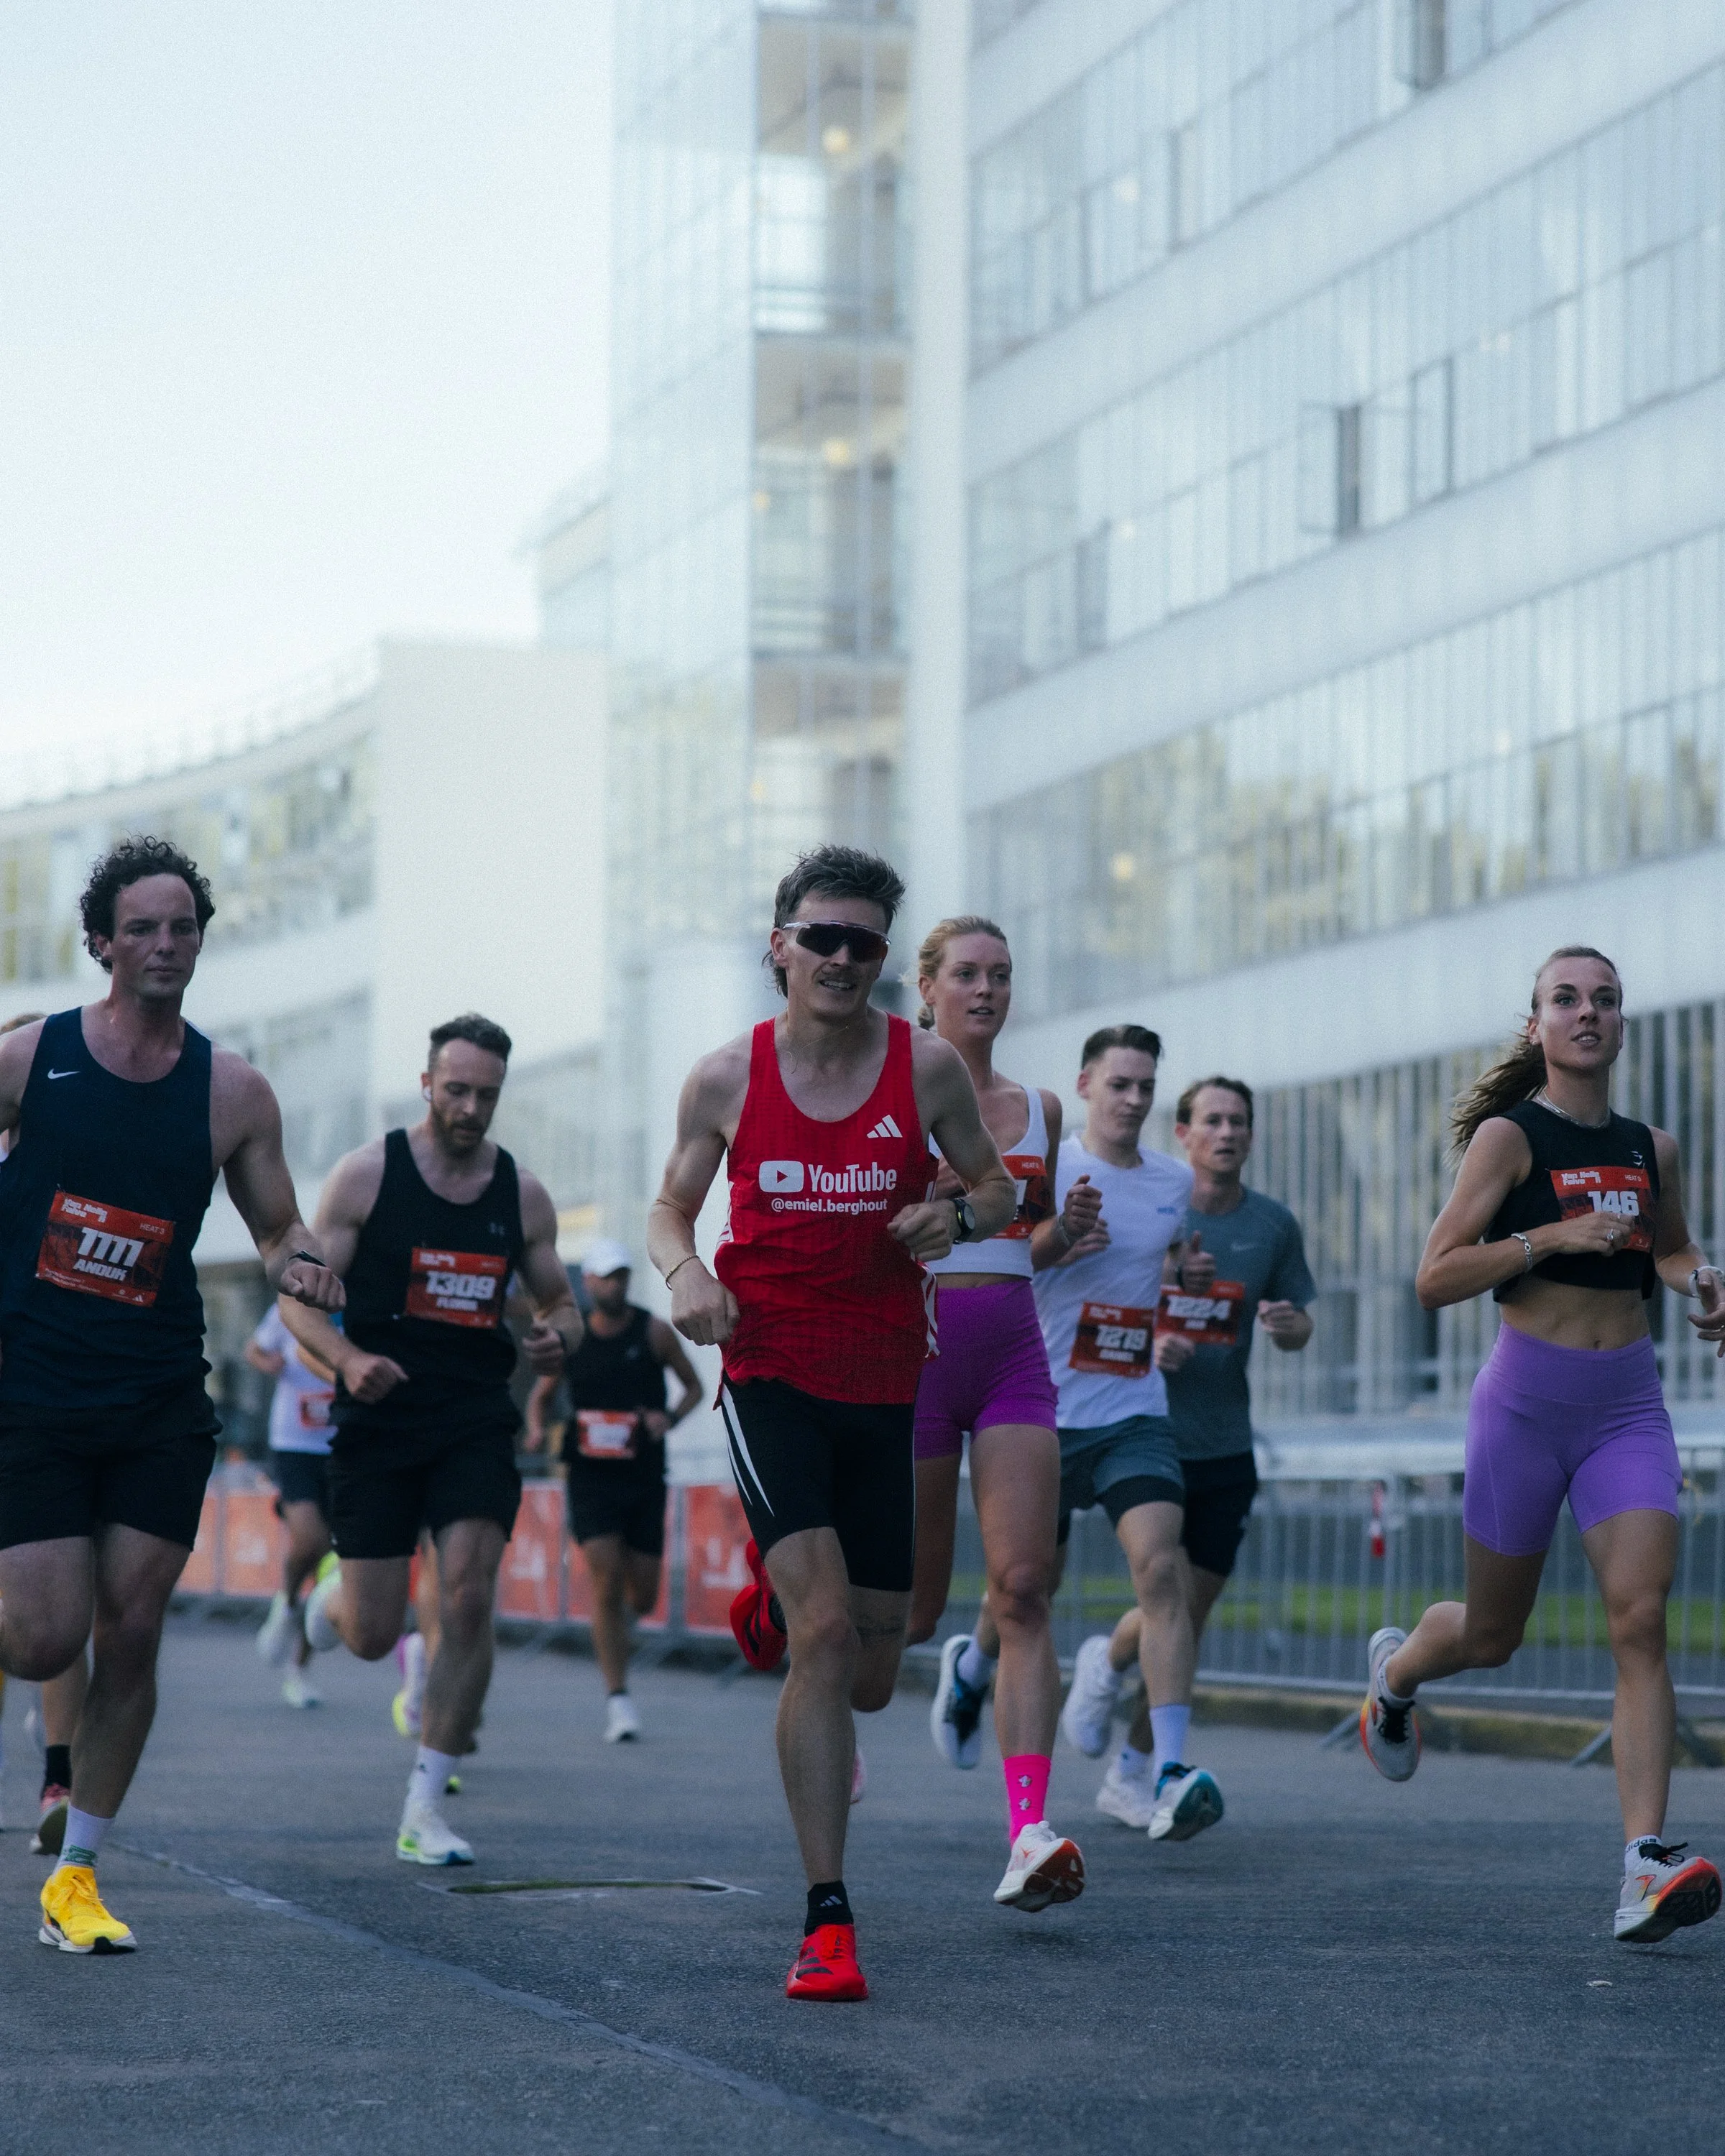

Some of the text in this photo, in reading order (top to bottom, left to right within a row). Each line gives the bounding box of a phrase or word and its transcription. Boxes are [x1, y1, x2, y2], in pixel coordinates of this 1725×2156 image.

[808, 1161, 897, 1193] YouTube
[771, 1198, 888, 1215] @emiel.berghout
[1587, 1191, 1639, 1216] 146
[139, 1223, 159, 1233] HEAT
[77, 1227, 144, 1268] 1111
[73, 1258, 128, 1281] ANOUK
[426, 1271, 496, 1300] 1309
